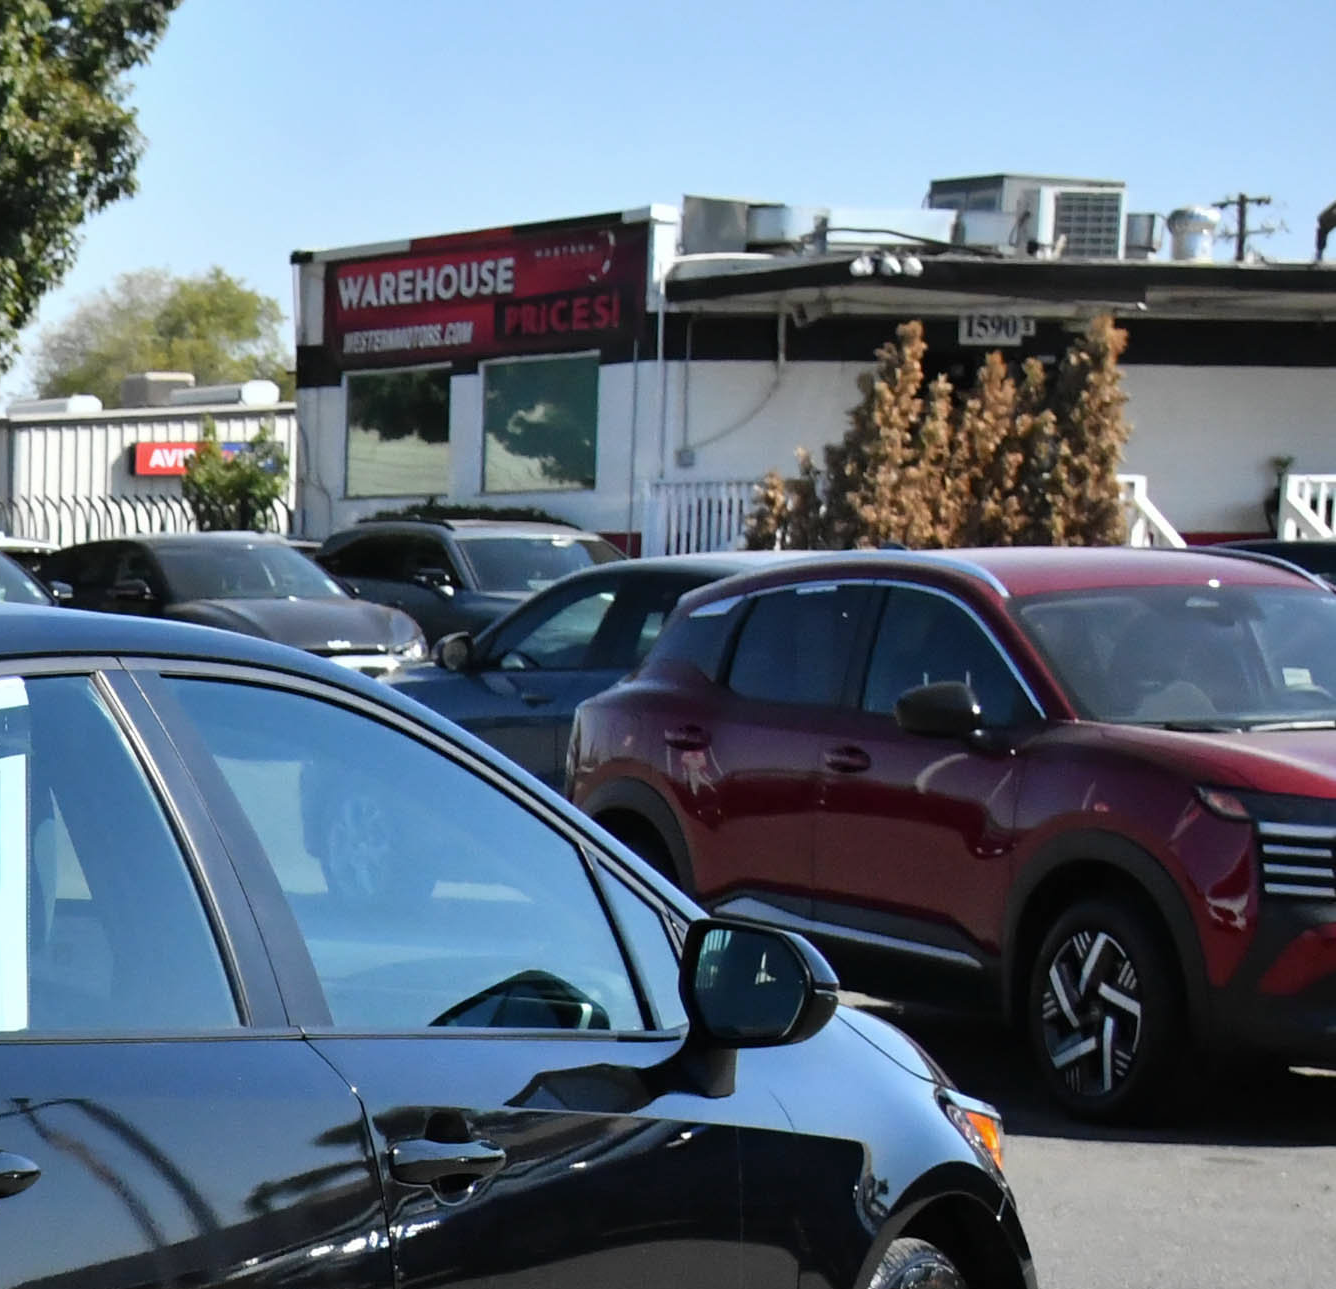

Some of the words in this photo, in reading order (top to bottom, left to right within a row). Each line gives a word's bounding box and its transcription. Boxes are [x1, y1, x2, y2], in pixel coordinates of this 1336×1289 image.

[339, 257, 515, 310] WAREHOUSE
[506, 290, 619, 335] PRICES!
[966, 314, 1018, 339] 1590
